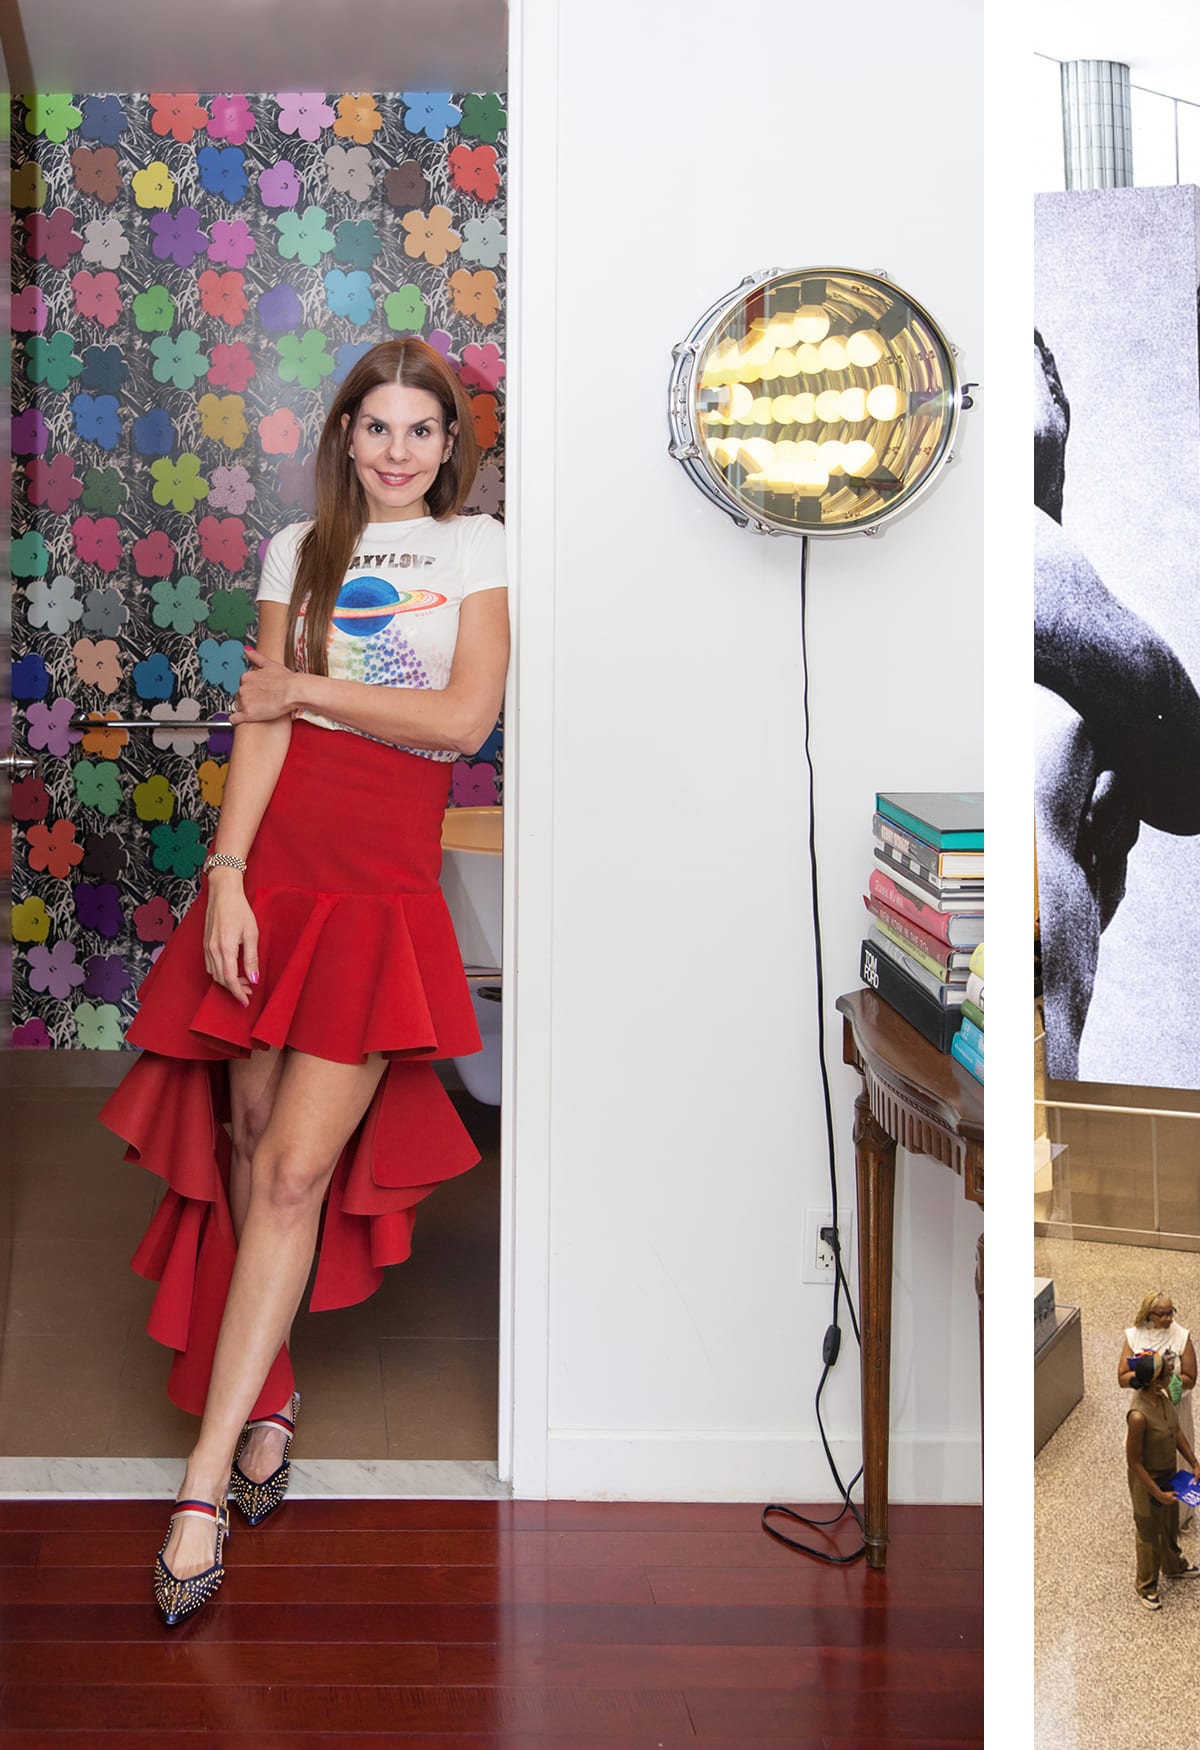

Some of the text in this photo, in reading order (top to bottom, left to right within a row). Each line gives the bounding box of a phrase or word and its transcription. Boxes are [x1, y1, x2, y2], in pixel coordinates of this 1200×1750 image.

[348, 554, 387, 570] AXY
[864, 949, 878, 972] TOM
[863, 967, 879, 989] FORD
